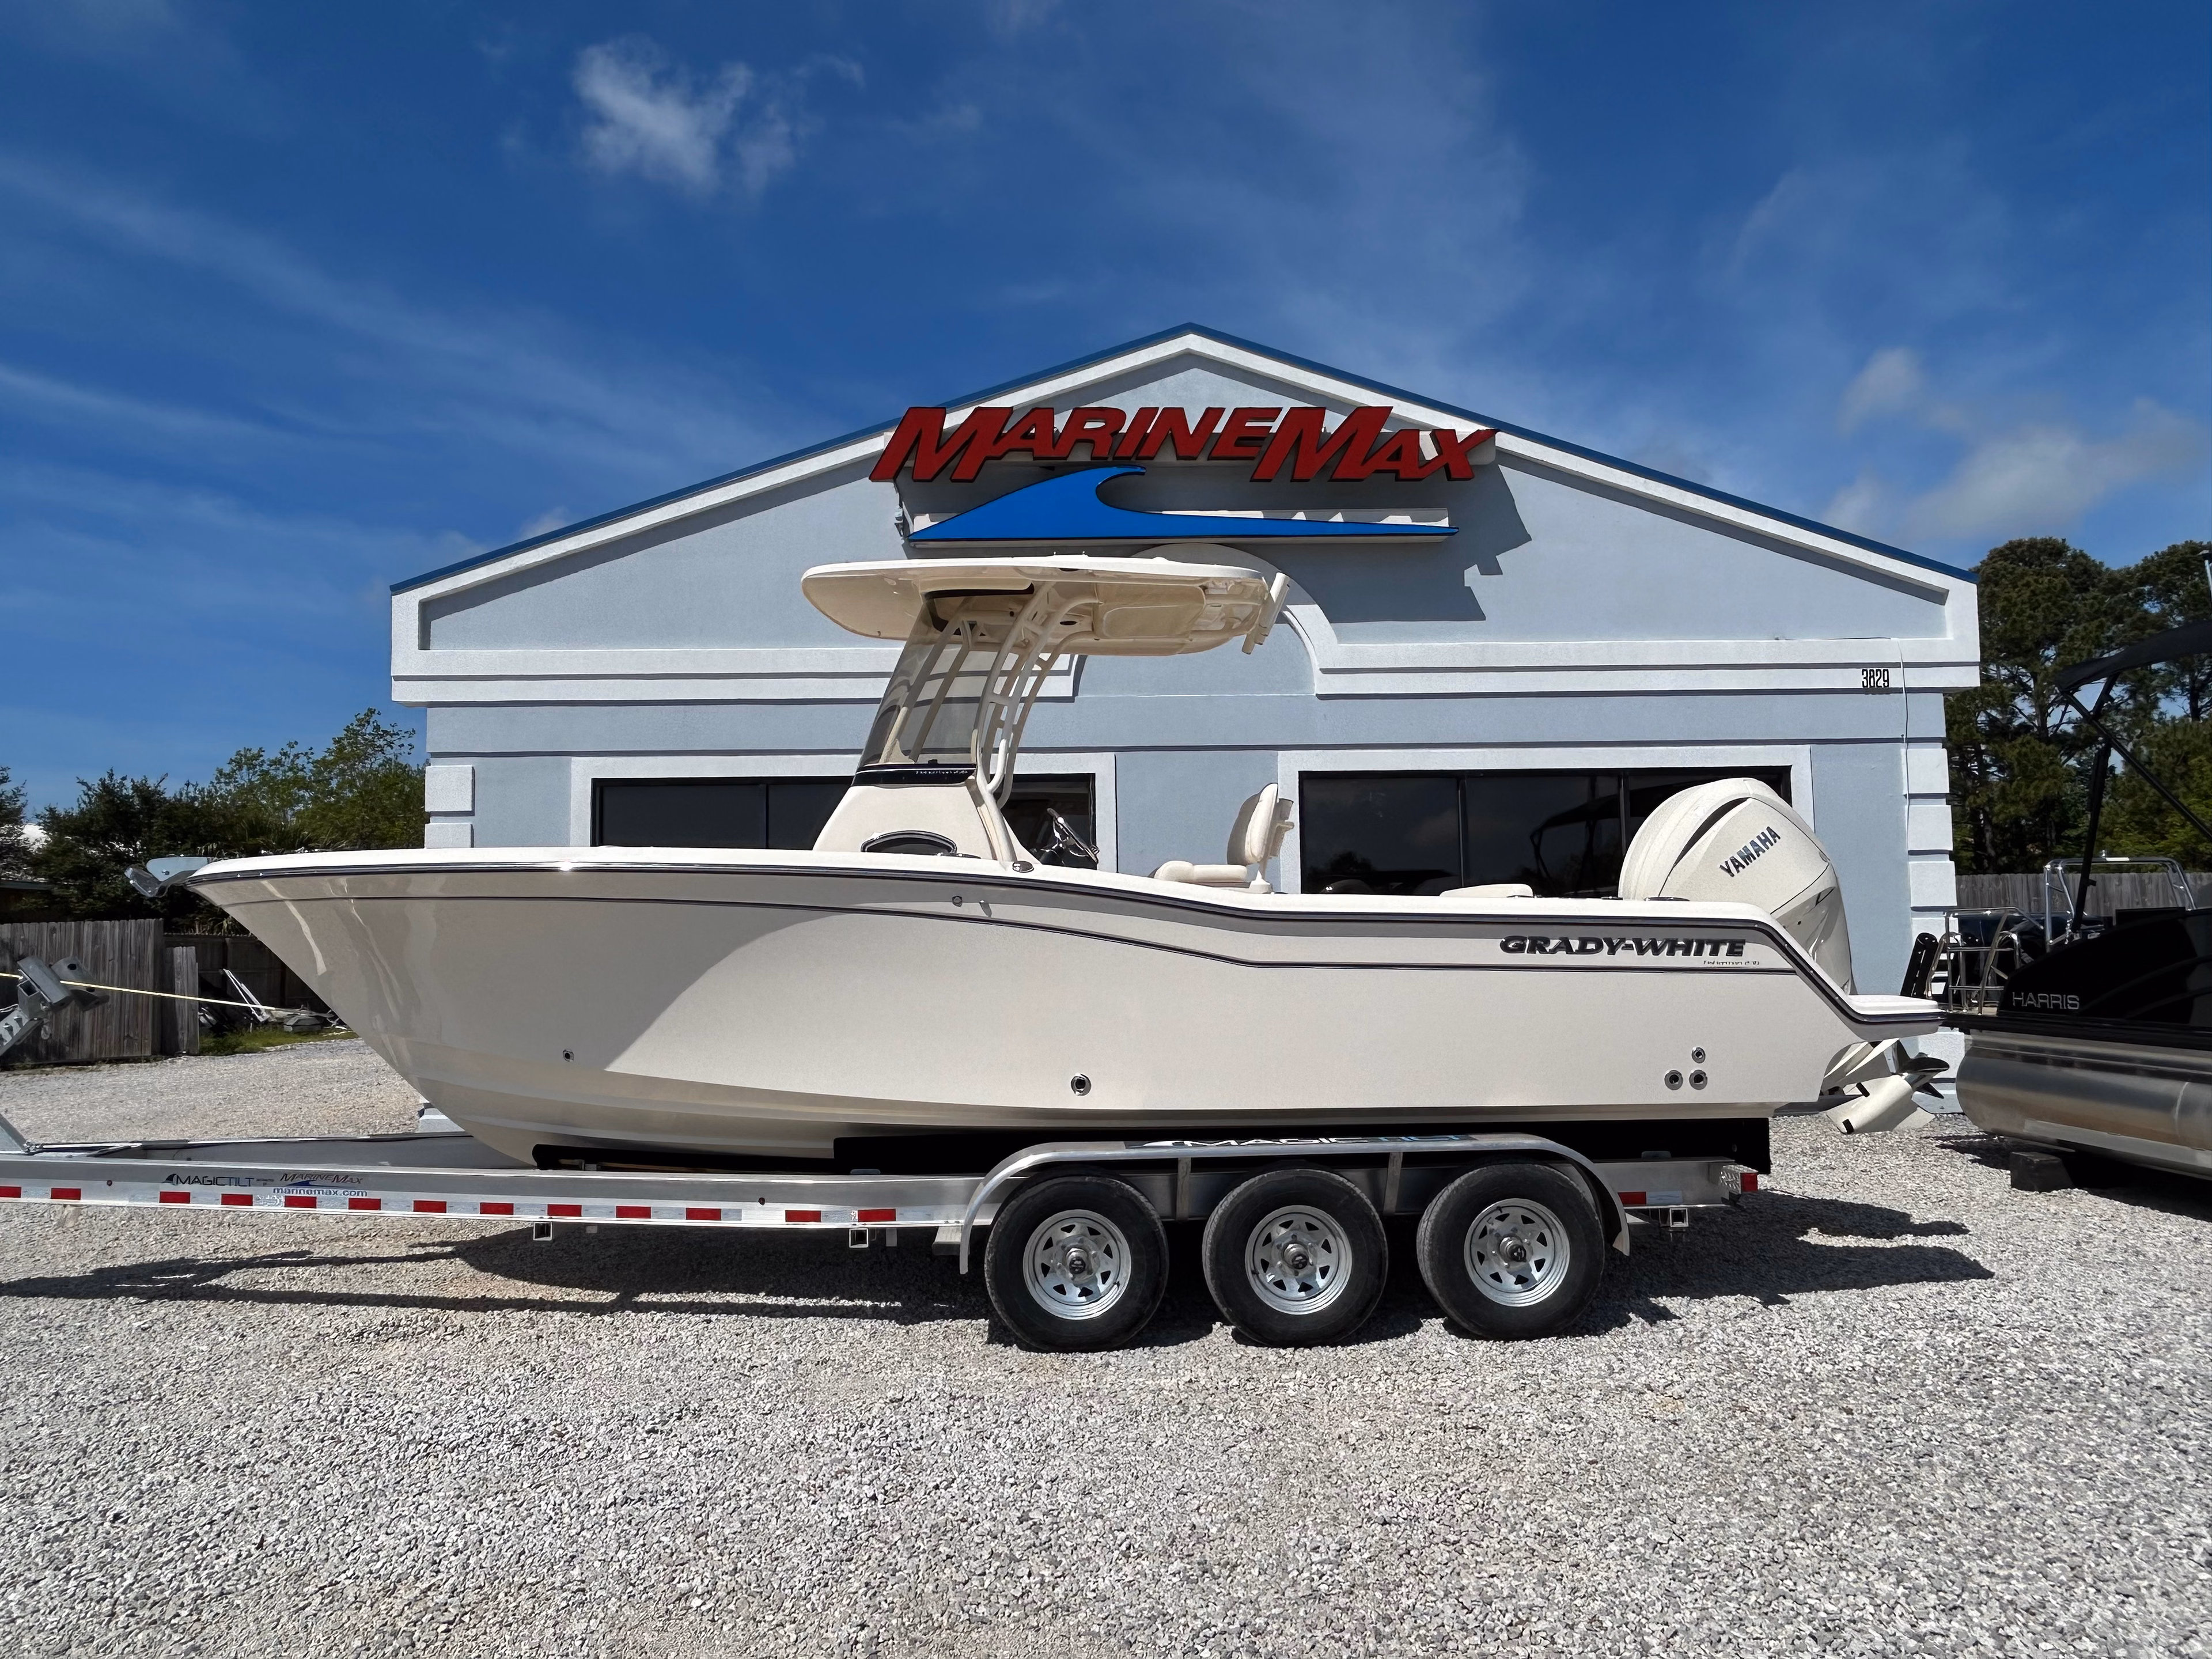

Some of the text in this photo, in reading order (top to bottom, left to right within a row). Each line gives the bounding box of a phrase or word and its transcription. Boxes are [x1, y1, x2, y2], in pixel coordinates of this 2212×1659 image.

[869, 406, 1498, 482] MARINEMAX
[1861, 668, 1889, 688] 3829
[1719, 825, 1781, 877] YAMAHA
[1499, 935, 1746, 957] GRADY-WHITE
[2012, 991, 2080, 1010] HARRIS
[176, 1174, 255, 1187] MAGICTILT
[280, 1173, 363, 1184] MARINEMAX
[272, 1187, 368, 1197] marinemax.com
